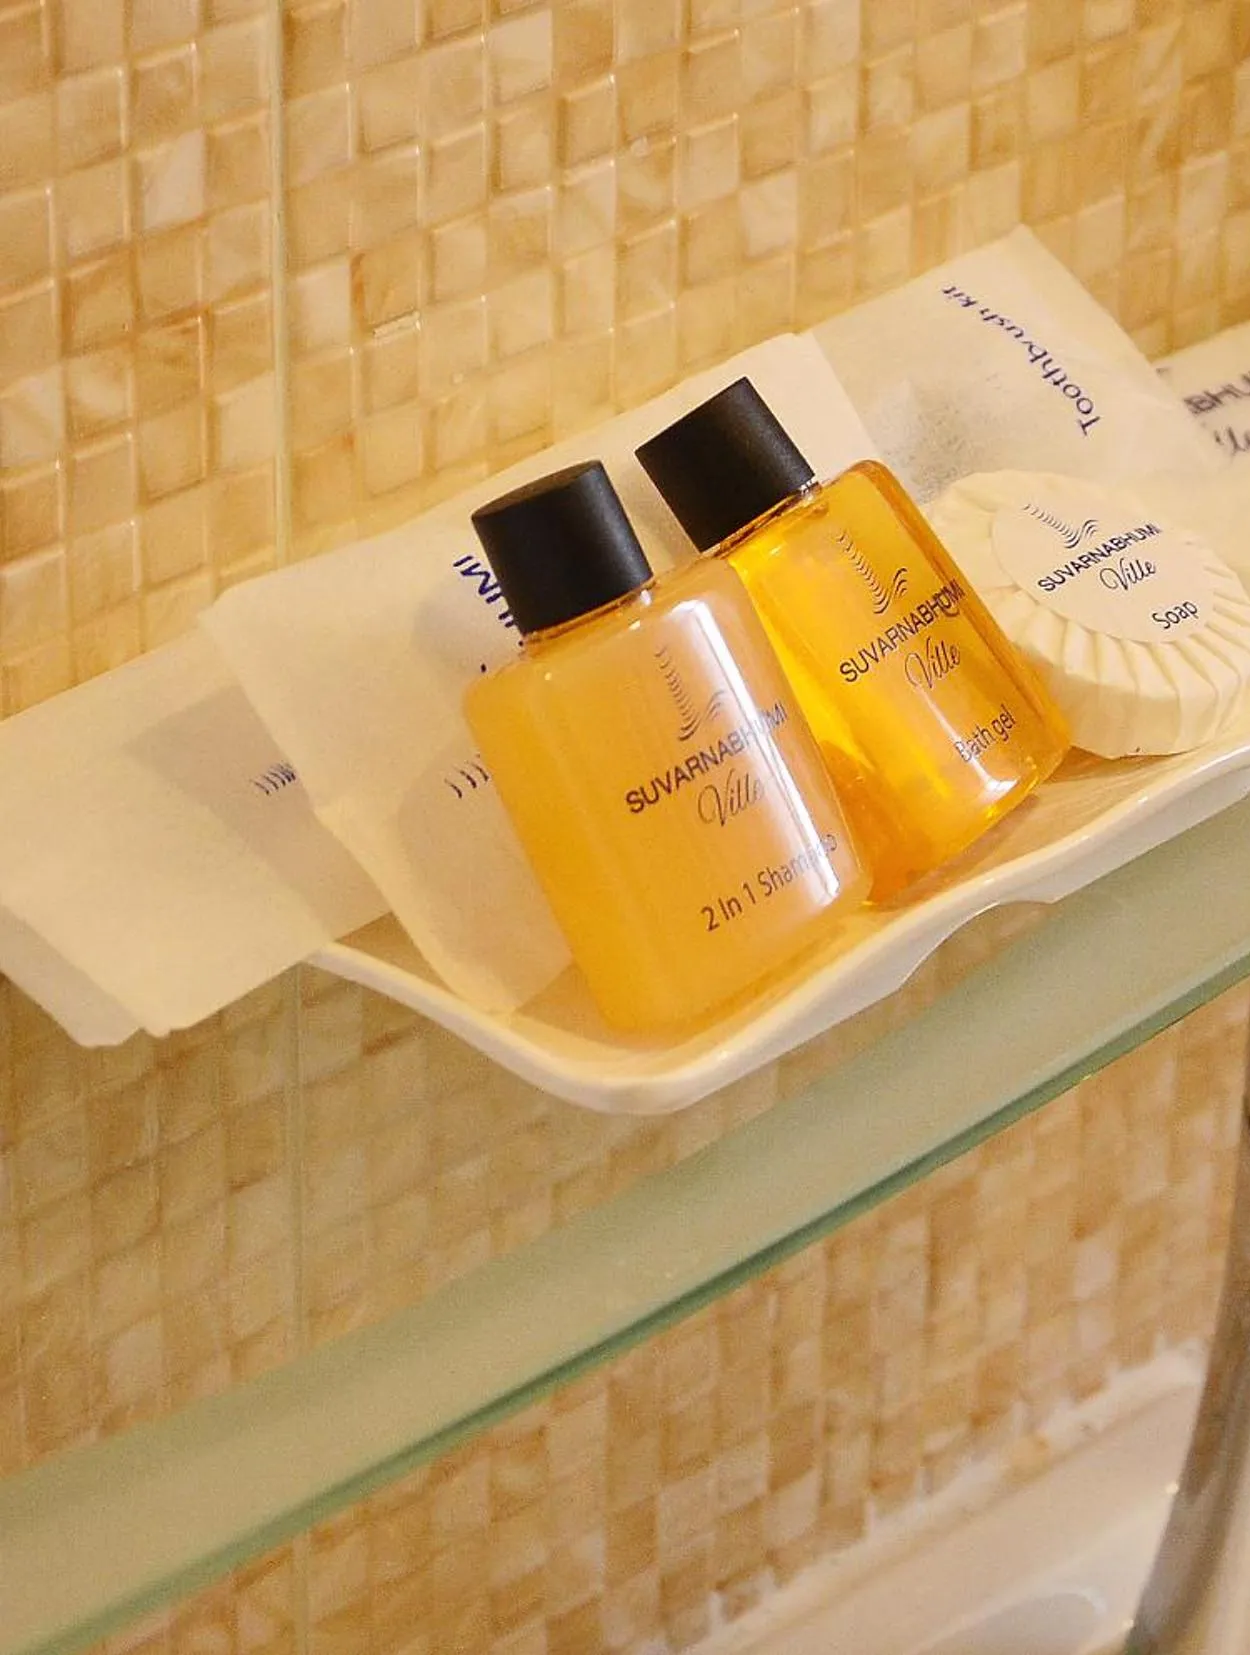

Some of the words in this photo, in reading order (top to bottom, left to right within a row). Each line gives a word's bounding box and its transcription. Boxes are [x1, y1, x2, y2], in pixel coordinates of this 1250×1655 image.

[942, 286, 977, 307] kit
[980, 308, 1100, 437] Toothbrush
[1037, 523, 1162, 593] SUVARNABHUMI
[1099, 557, 1156, 591] Ville
[839, 578, 966, 683] SUVARNABHUMI
[1151, 600, 1199, 630] Soap
[904, 636, 961, 689] Ville
[955, 725, 994, 762] Bath
[992, 704, 1016, 742] gel
[700, 906, 720, 932] 2
[719, 897, 742, 921] In
[742, 882, 757, 905] 1
